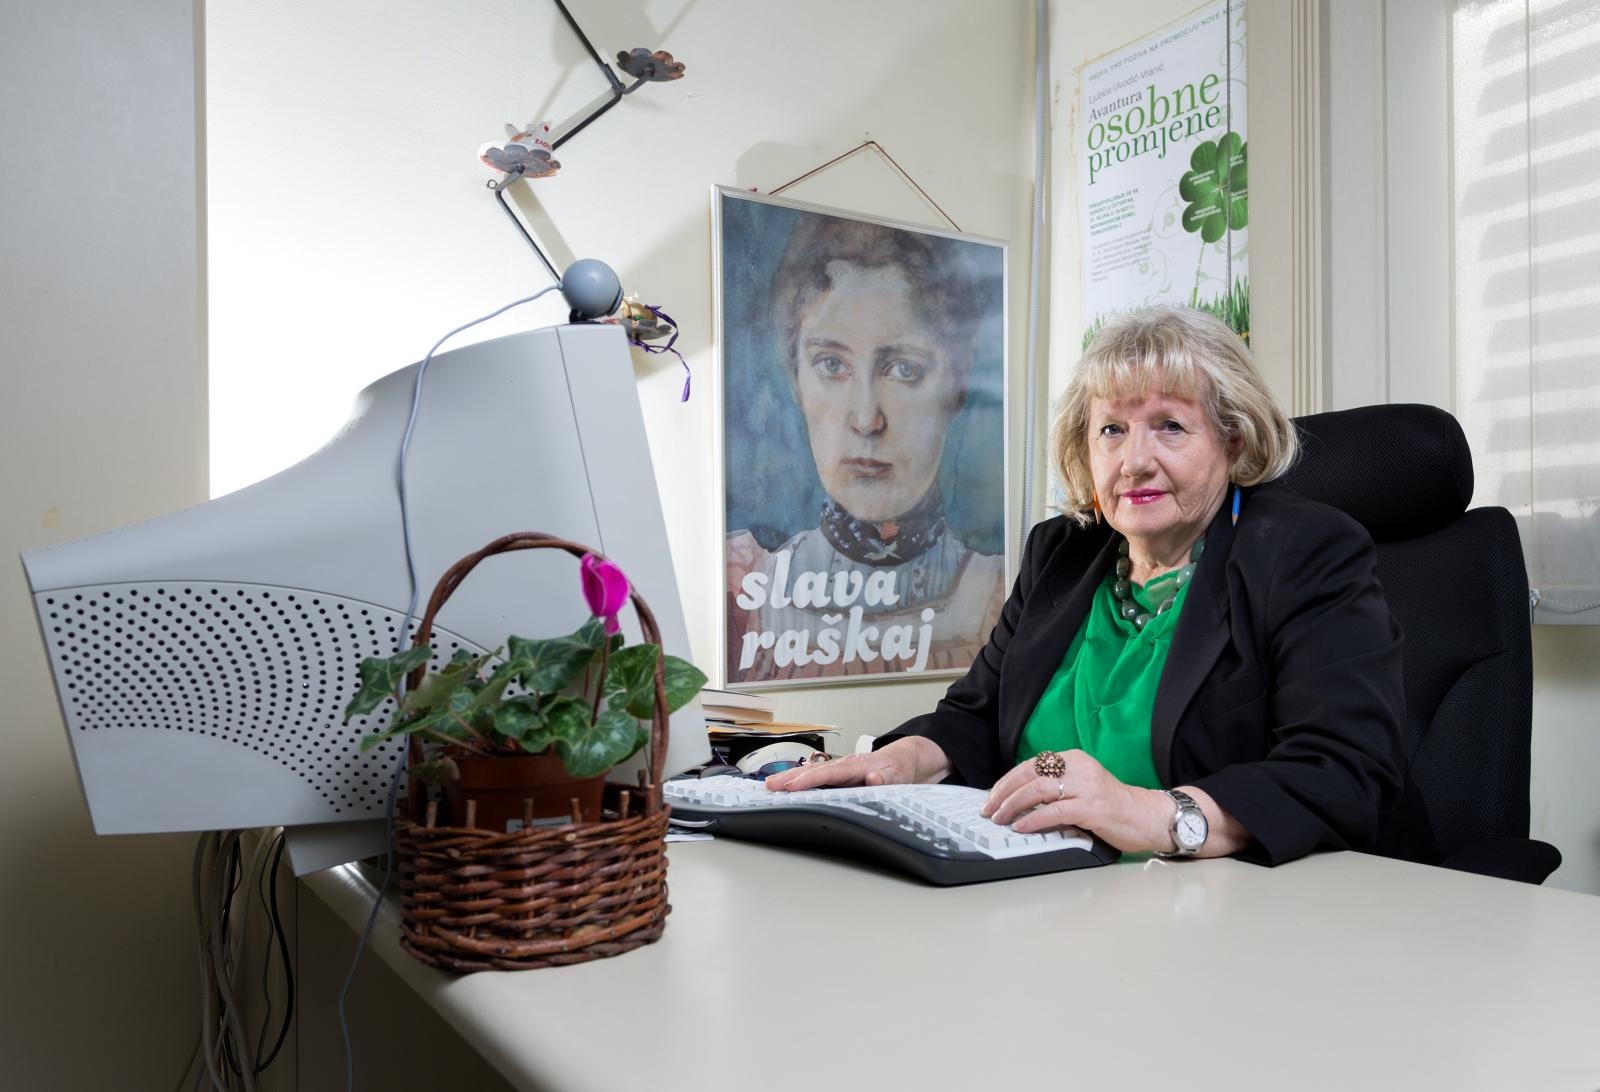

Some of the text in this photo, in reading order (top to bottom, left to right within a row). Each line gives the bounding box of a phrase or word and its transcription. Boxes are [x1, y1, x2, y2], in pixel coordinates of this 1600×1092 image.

[1123, 49, 1148, 64] POZIVA
[1149, 43, 1158, 54] NA
[1160, 23, 1200, 48] PROMOCIJU
[1201, 11, 1220, 25] NOVE
[1222, 0, 1248, 16] KJIG
[1087, 73, 1220, 150] osobne
[1088, 91, 1143, 123] Avantura
[1088, 105, 1221, 185] promjene
[735, 549, 900, 611] slava
[738, 605, 936, 673] raškaj
